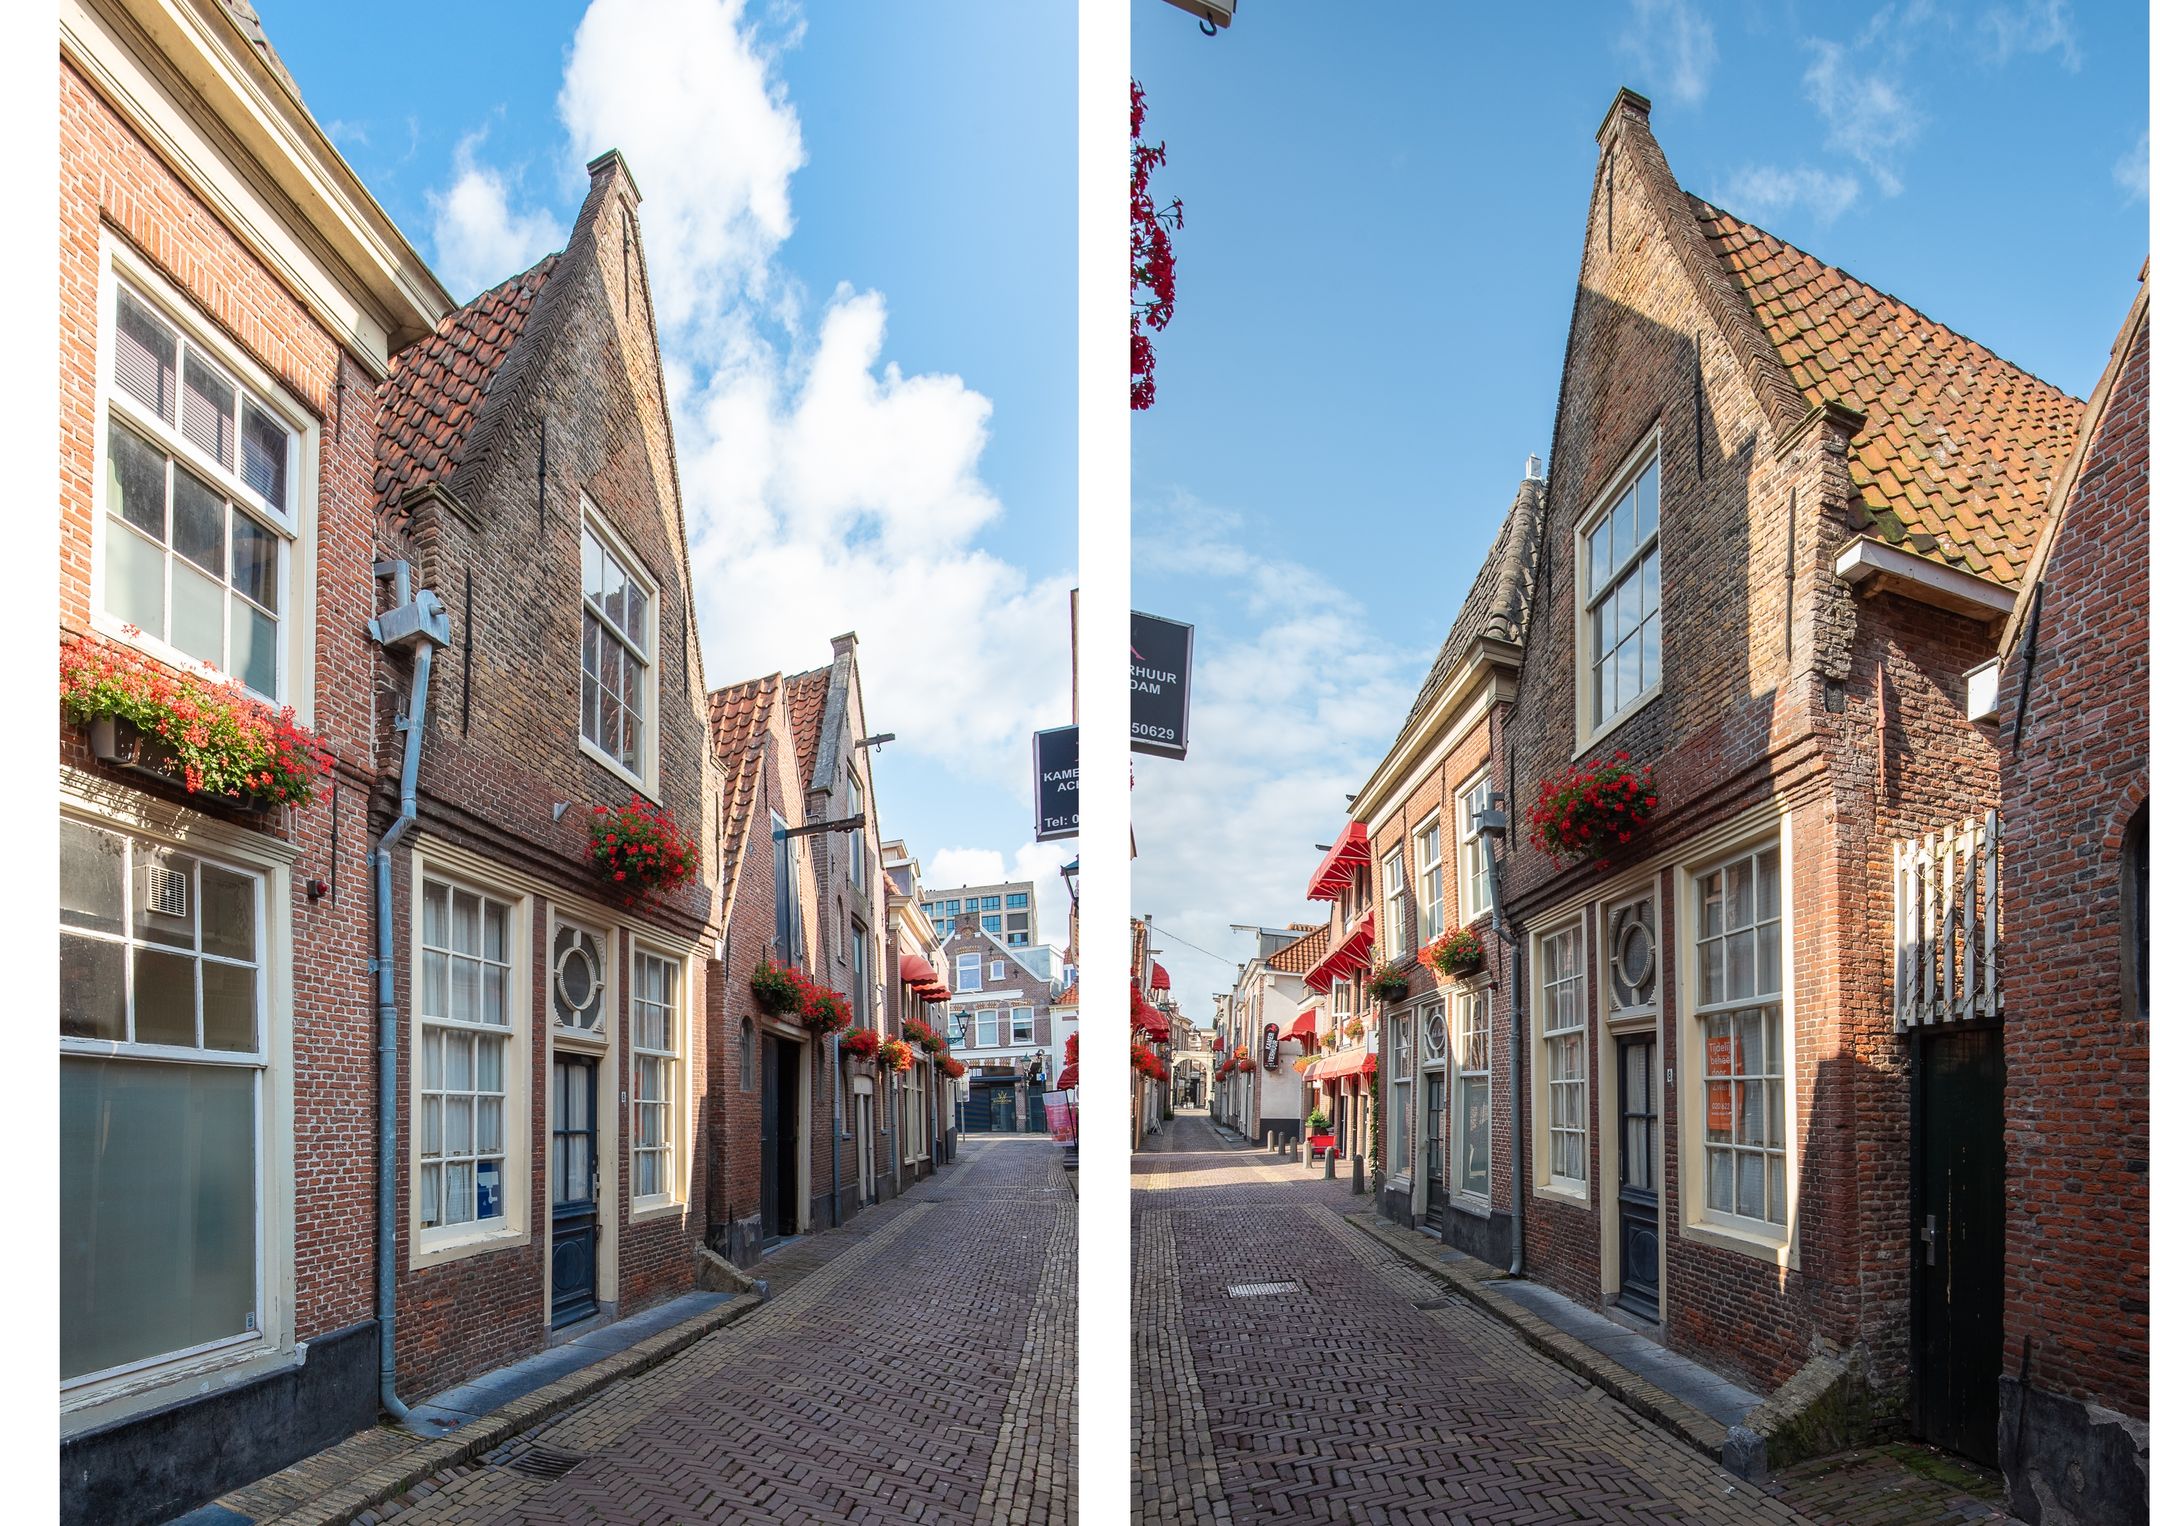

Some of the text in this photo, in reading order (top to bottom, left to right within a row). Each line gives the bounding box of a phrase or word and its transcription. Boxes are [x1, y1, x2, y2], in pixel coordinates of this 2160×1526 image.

[1131, 722, 1175, 740] 50629
[1043, 768, 1079, 782] KAME
[1044, 815, 1068, 828] Tel:
[1708, 1041, 1731, 1055] Tijdelij
[1710, 1055, 1731, 1065] behee
